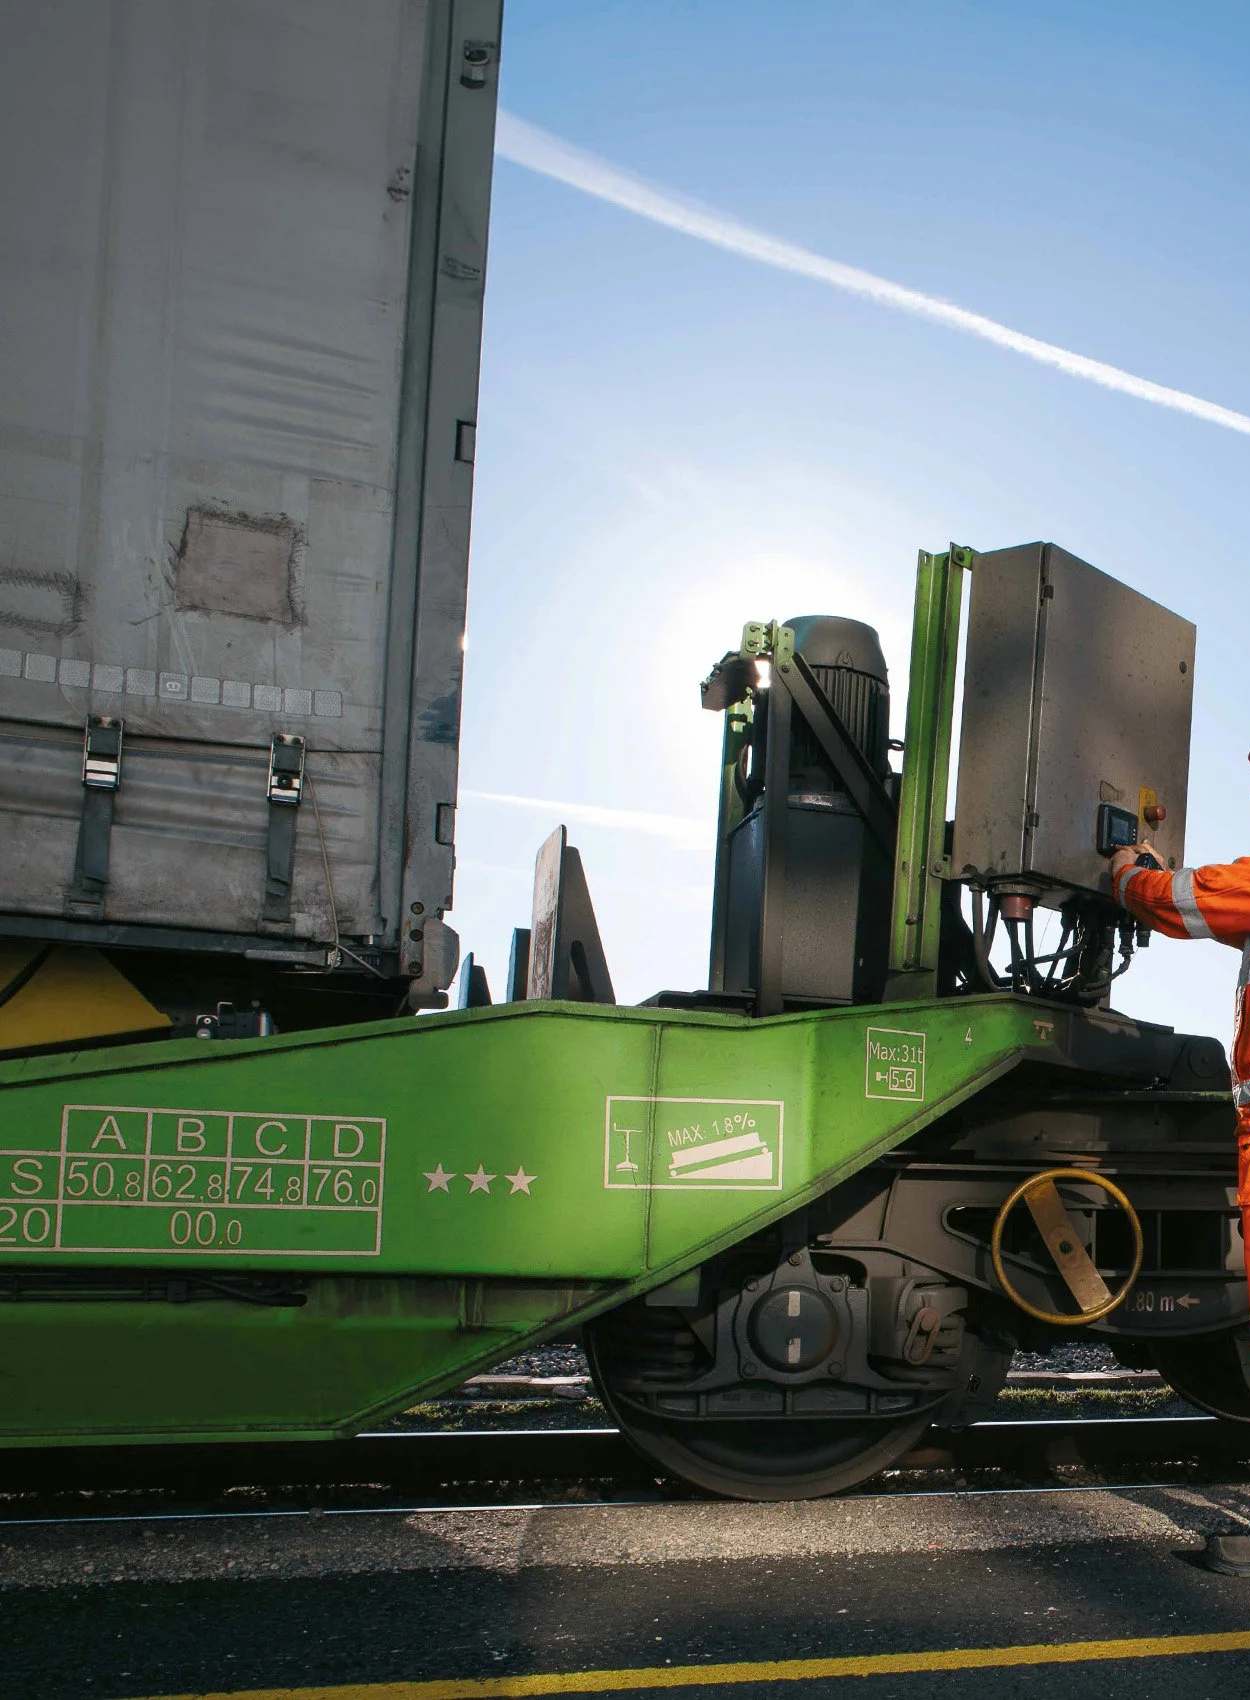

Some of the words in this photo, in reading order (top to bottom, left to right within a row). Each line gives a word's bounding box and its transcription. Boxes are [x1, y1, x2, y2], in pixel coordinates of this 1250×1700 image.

[964, 1026, 973, 1046] 4
[890, 1069, 914, 1090] 5-6
[91, 1115, 127, 1150] A
[177, 1117, 207, 1152] B
[255, 1120, 288, 1156] C
[333, 1124, 364, 1158] D
[11, 1158, 43, 1195] S
[1159, 1295, 1175, 1312] m
